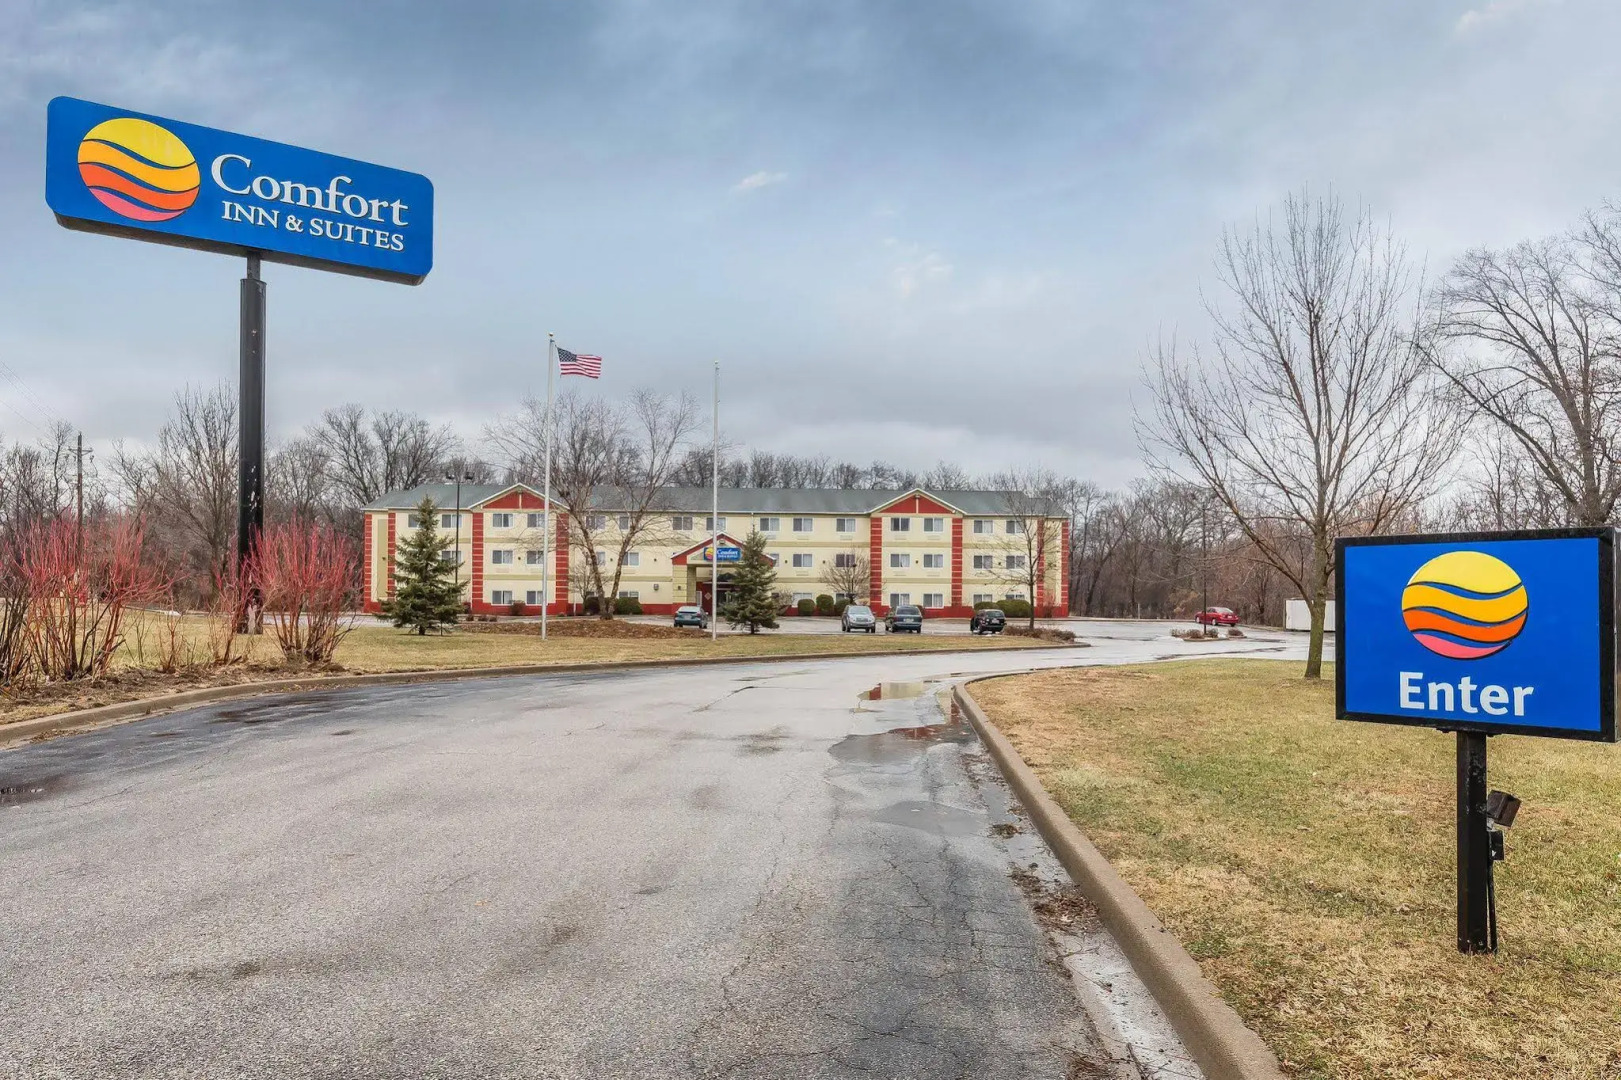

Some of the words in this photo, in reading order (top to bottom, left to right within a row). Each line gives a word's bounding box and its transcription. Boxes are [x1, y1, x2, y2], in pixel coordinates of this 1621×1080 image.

[211, 153, 409, 226] Comfort
[221, 200, 280, 229] INN
[285, 214, 304, 233] &
[309, 217, 405, 251] SUITES
[1399, 671, 1535, 717] Enter
